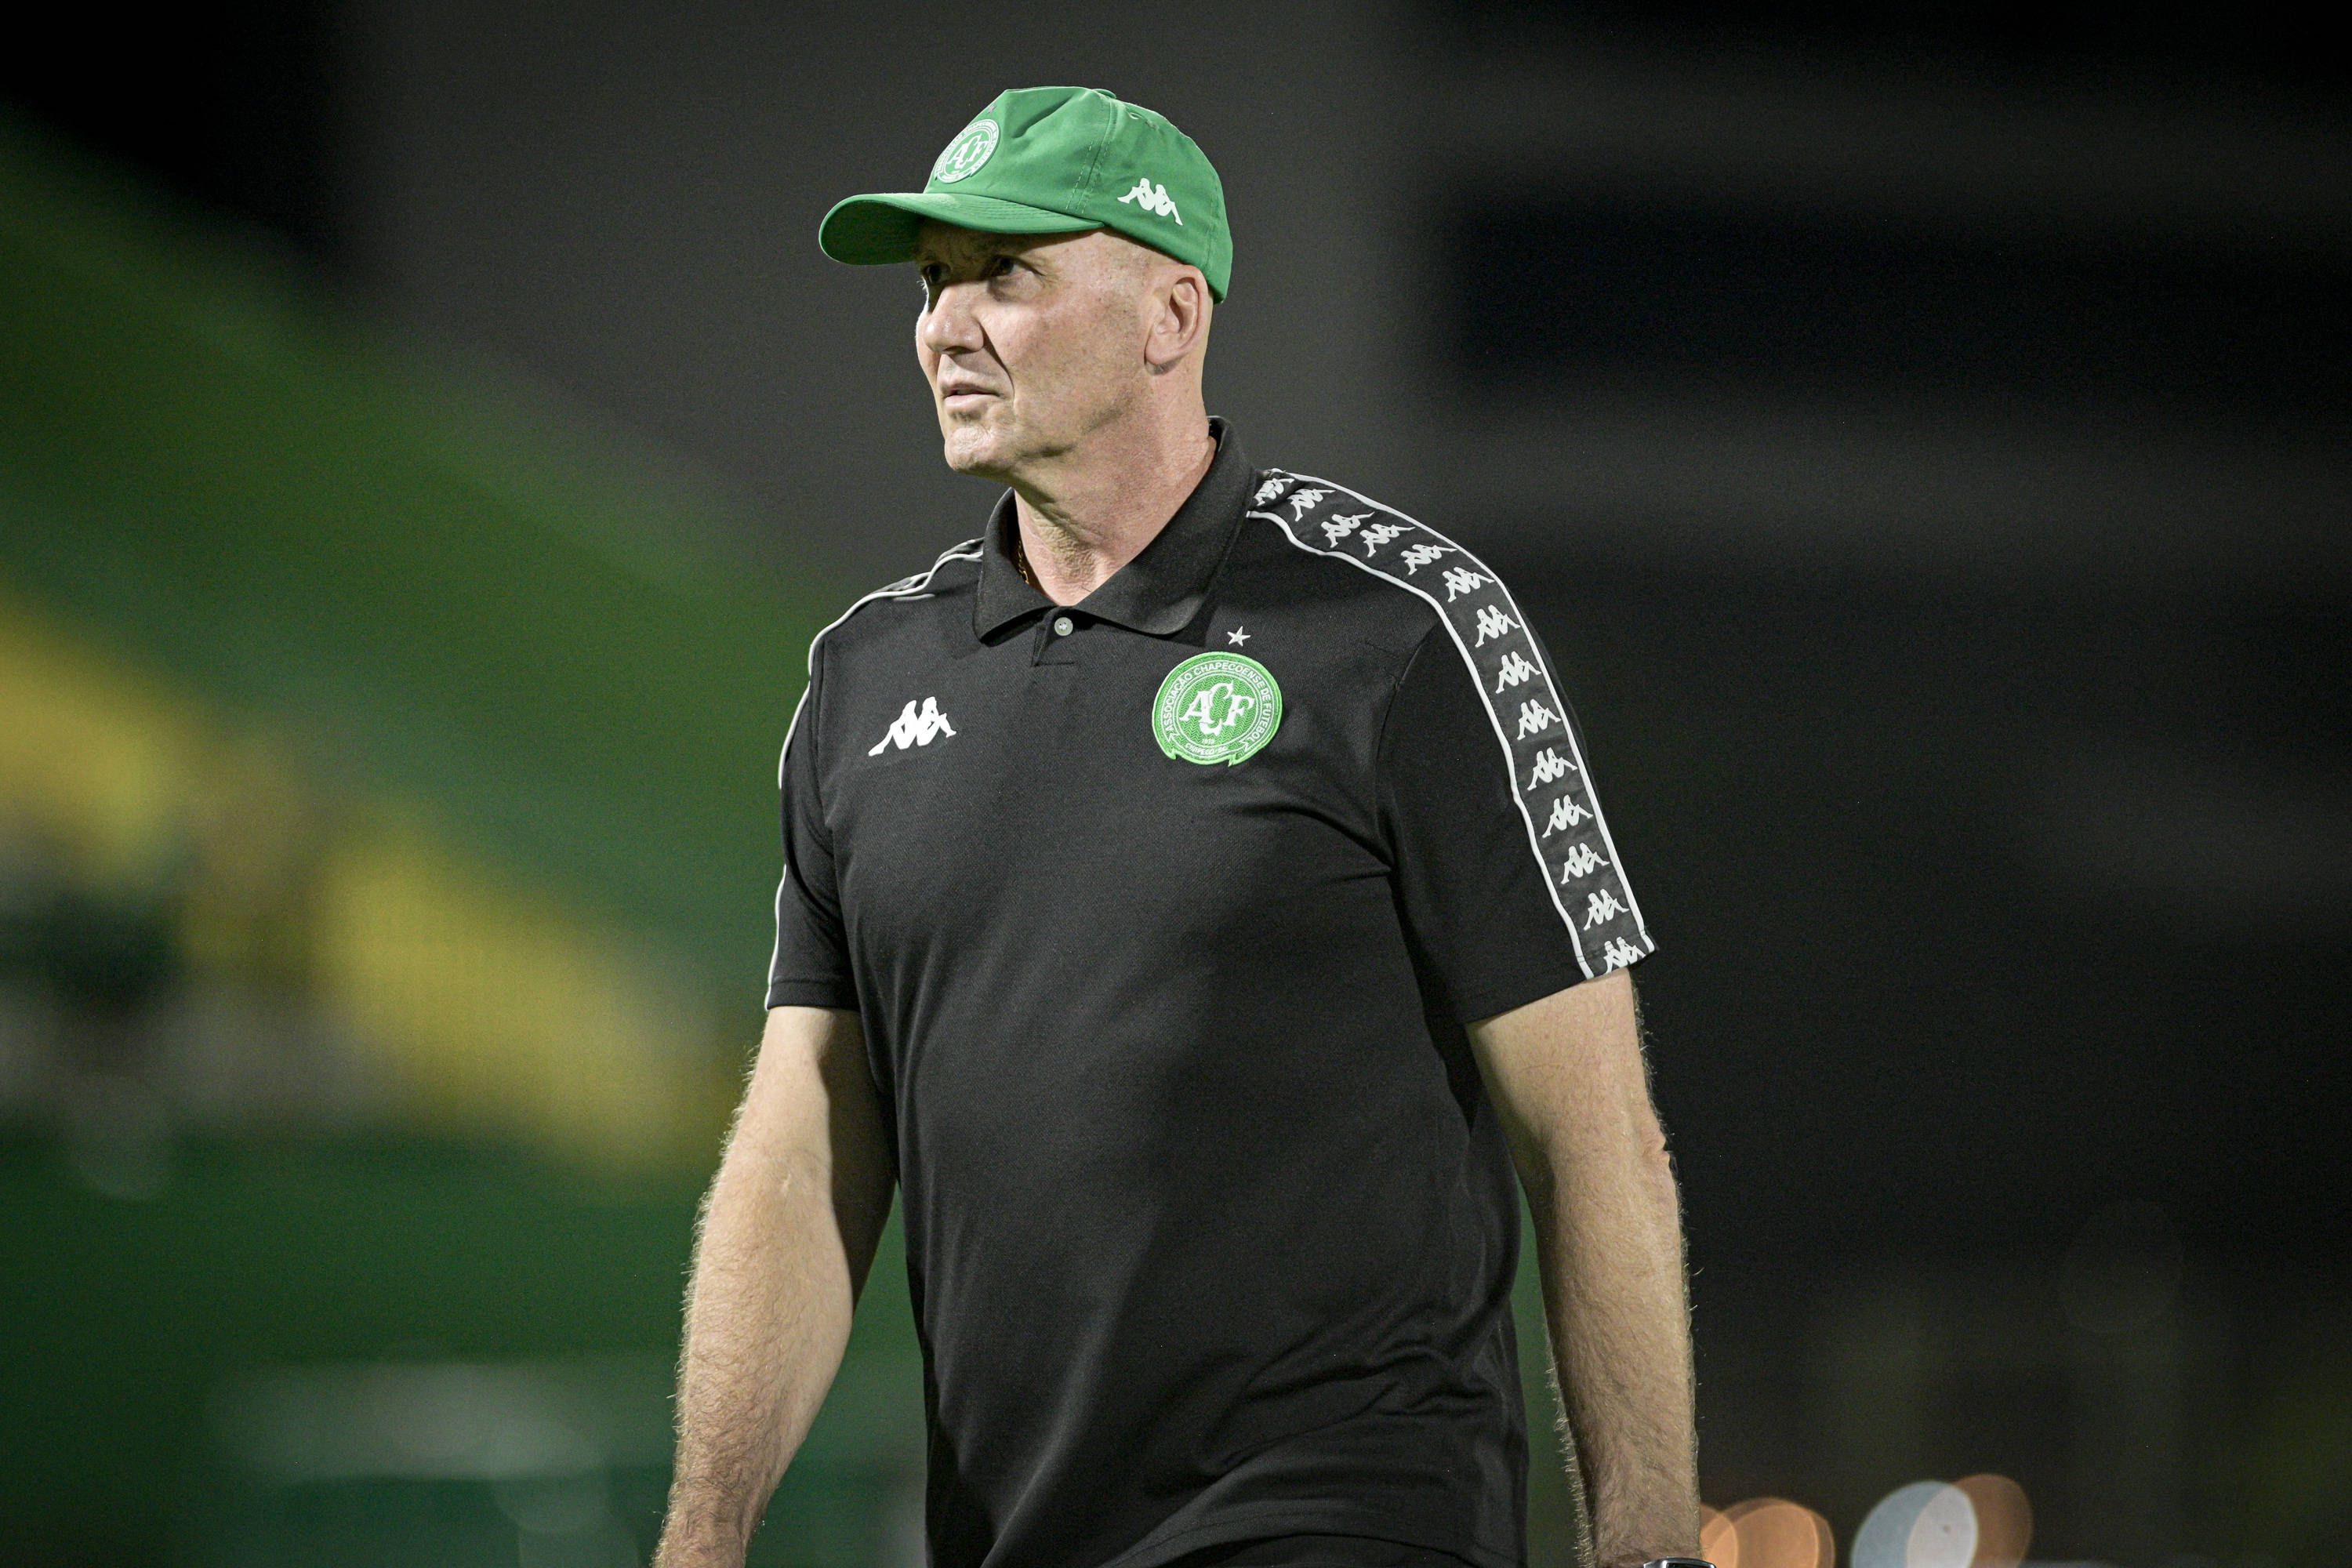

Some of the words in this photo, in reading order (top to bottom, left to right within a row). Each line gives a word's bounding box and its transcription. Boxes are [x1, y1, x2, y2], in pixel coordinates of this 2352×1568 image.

[1194, 662, 1265, 688] CHAPECOENSE
[1179, 680, 1255, 735] ACF
[1261, 688, 1271, 702] DE
[1247, 702, 1272, 742] FUTEBOL
